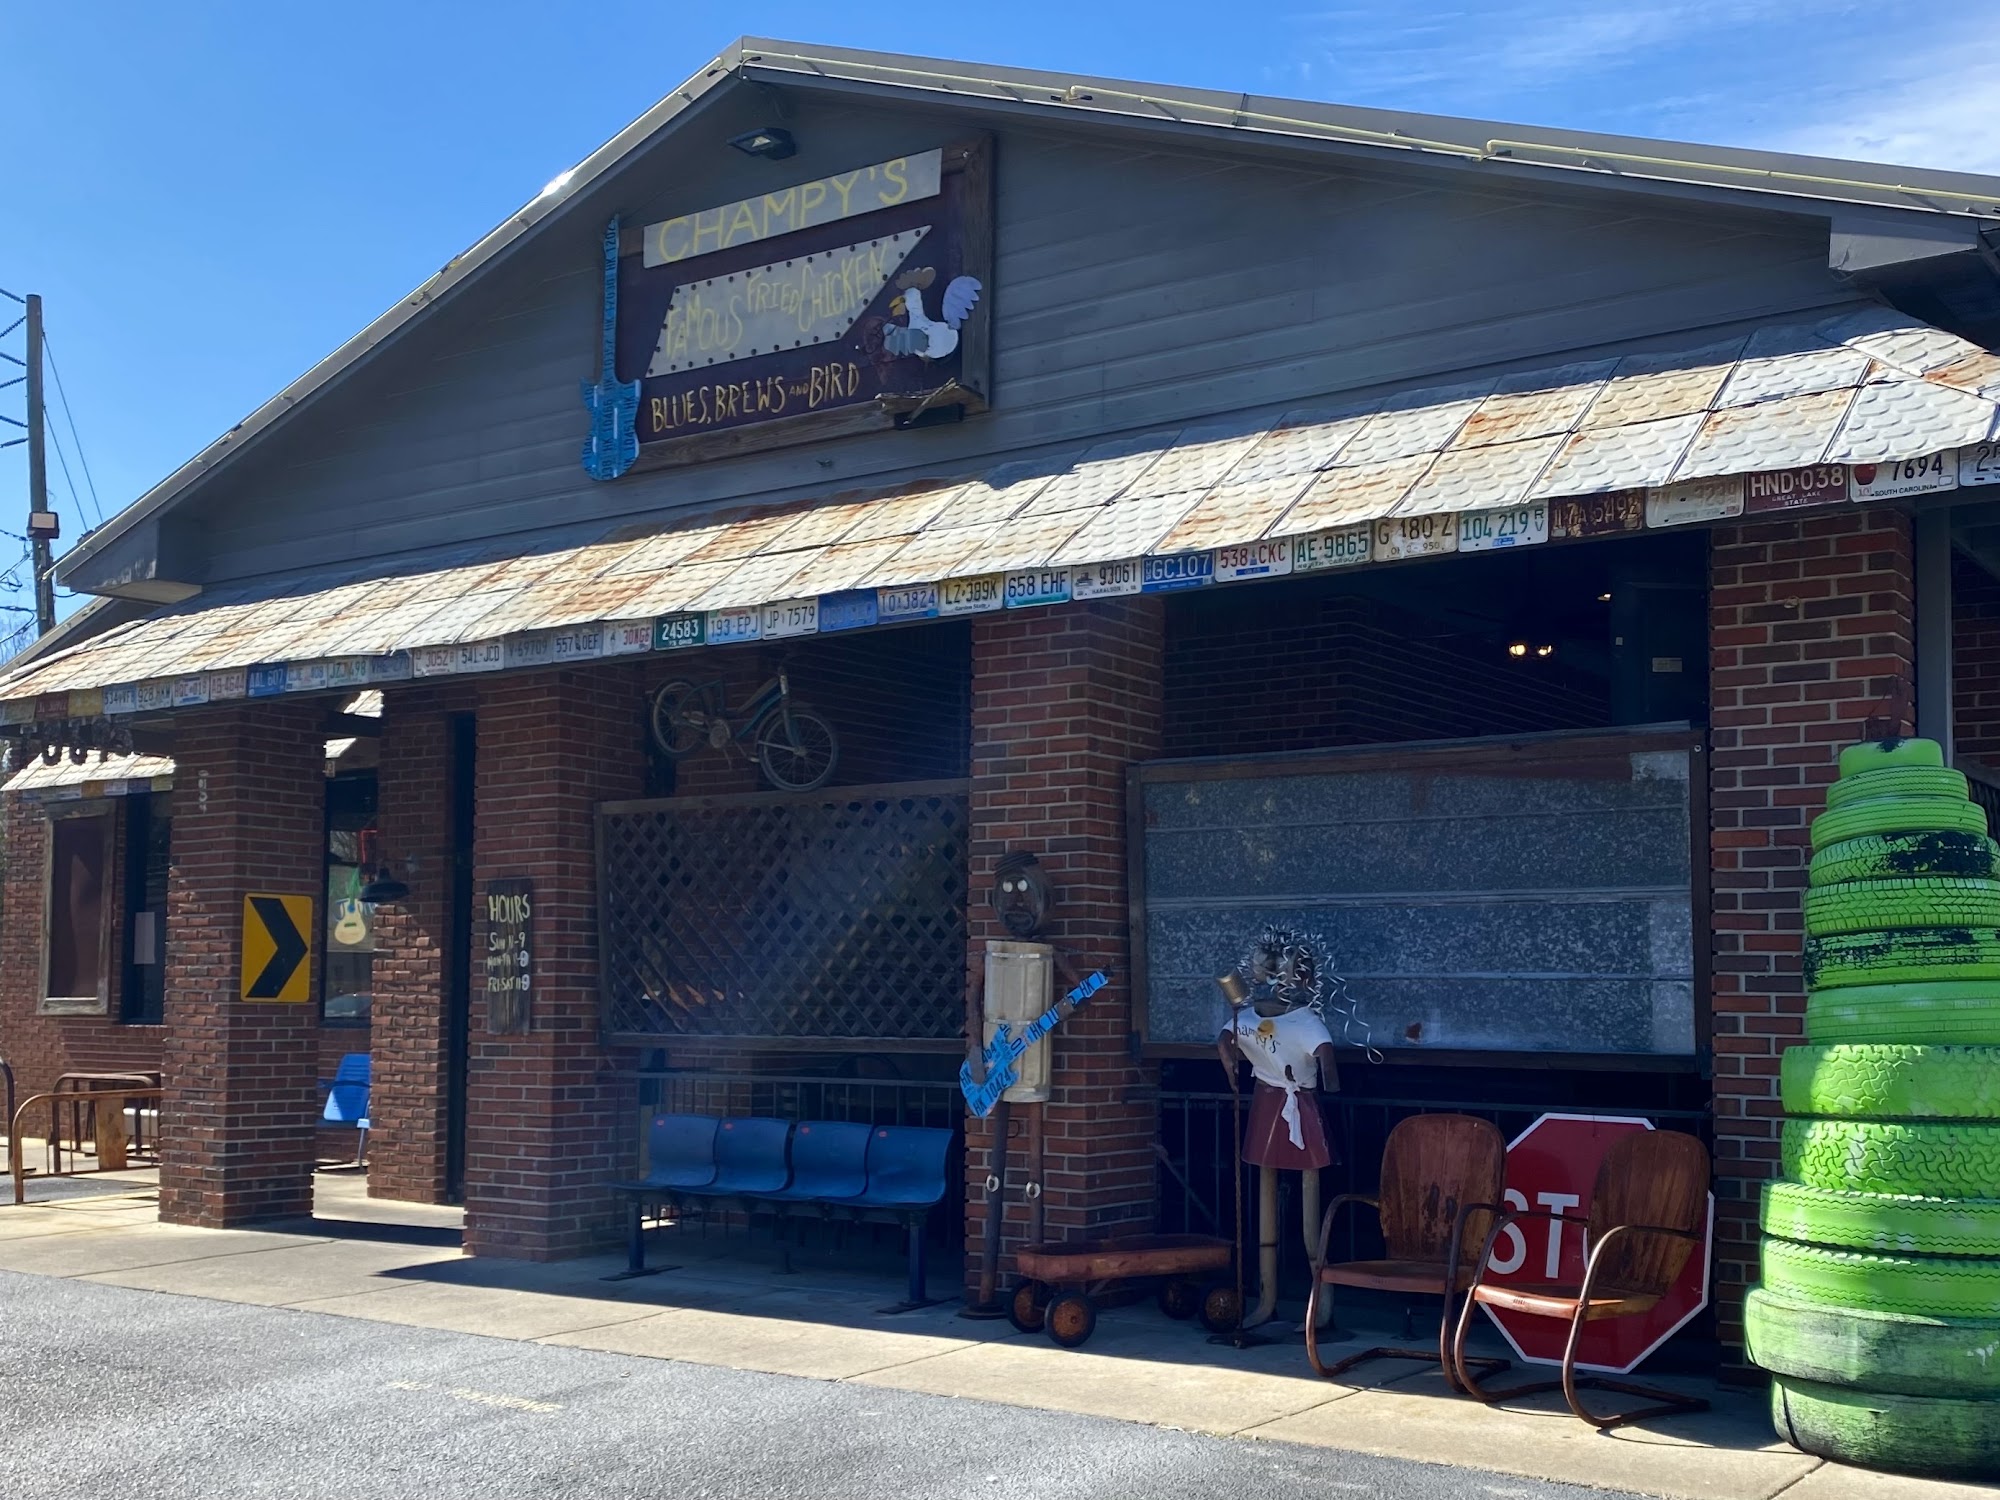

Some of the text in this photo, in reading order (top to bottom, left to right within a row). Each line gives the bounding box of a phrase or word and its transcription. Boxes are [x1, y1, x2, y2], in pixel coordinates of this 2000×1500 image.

[658, 158, 908, 262] CHAMPY'S
[665, 241, 889, 359] FAMOUS FRIED CHICKEN
[651, 362, 859, 433] BLUES, BREWS AND BIRD
[1771, 493, 1797, 502] GREAT
[1784, 498, 1808, 506] STATE
[1874, 487, 1898, 497] SOUTH
[1898, 484, 1937, 494] CAROLINA
[1462, 516, 1492, 542] 104
[1498, 510, 1528, 537] 219
[1152, 554, 1210, 580] GC107
[1220, 540, 1286, 569] 538 CKC
[1008, 570, 1068, 598] 658 EHF
[1099, 562, 1137, 586] 93061
[786, 605, 815, 626] 7579
[662, 618, 699, 641] 24583
[556, 636, 574, 653] 557
[488, 894, 530, 923] HOURS
[1079, 978, 1095, 997] HK
[1030, 1022, 1047, 1040] HK
[974, 1070, 1011, 1116] HK 10424
[1487, 1188, 1590, 1279] ST
